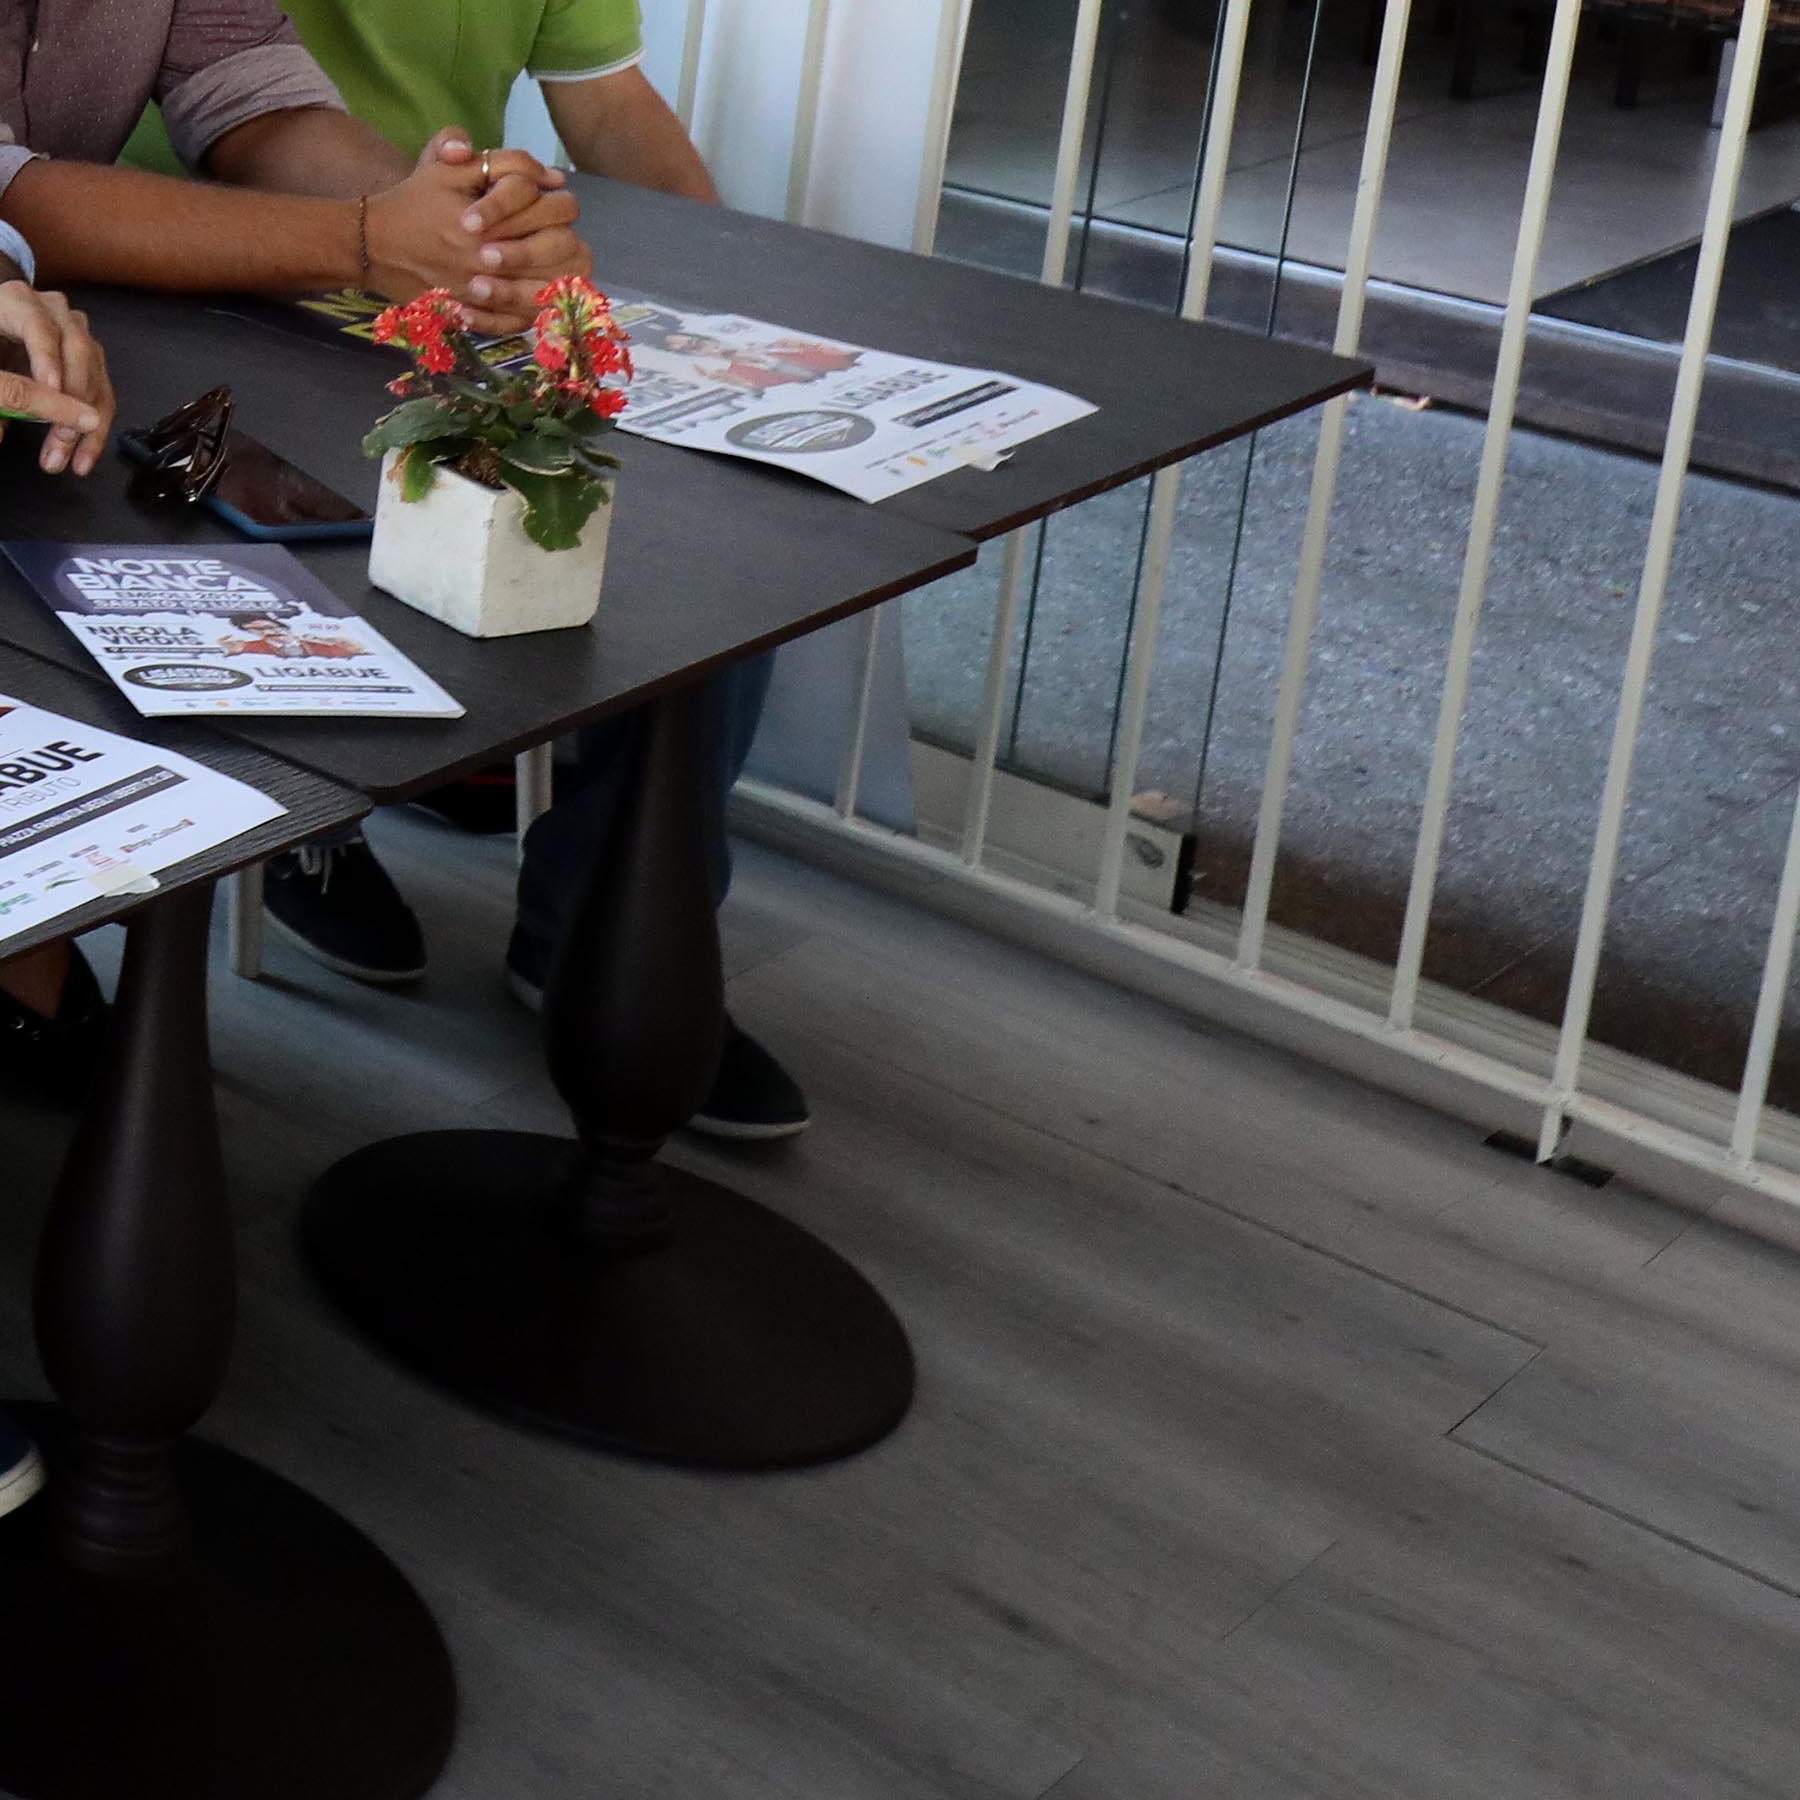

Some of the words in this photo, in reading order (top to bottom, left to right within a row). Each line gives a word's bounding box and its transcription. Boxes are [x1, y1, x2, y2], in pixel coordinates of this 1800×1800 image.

[72, 558, 231, 576] NOTTE
[67, 573, 260, 592] BIANCA
[85, 626, 201, 637] NICOLA
[97, 635, 203, 646] VIRDIS
[255, 667, 392, 680] LIGABUE
